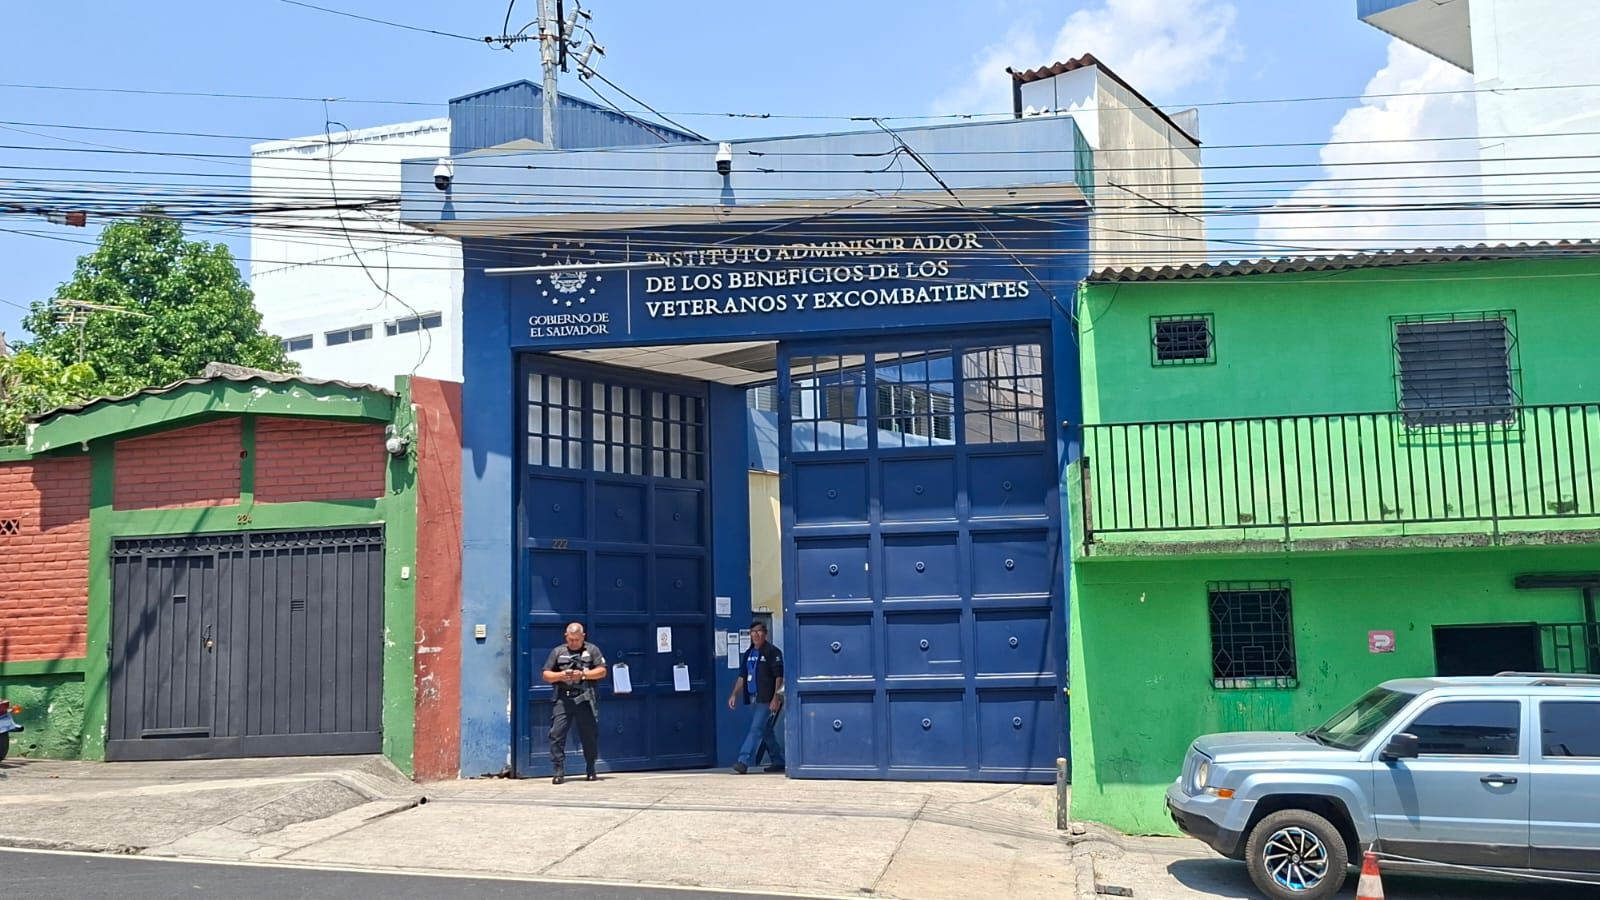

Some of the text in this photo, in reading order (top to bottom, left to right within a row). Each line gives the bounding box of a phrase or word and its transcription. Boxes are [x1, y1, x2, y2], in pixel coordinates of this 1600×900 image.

[646, 233, 984, 267] INSTITUTO ADMINISTRADOR
[645, 260, 949, 293] DE LOS BENEFICIOS DE LOS
[645, 281, 1030, 318] VETERANOS Y EXCOMBATIENTES
[528, 312, 609, 326] GOBIERNO DE
[530, 324, 609, 337] EL SALVADOR
